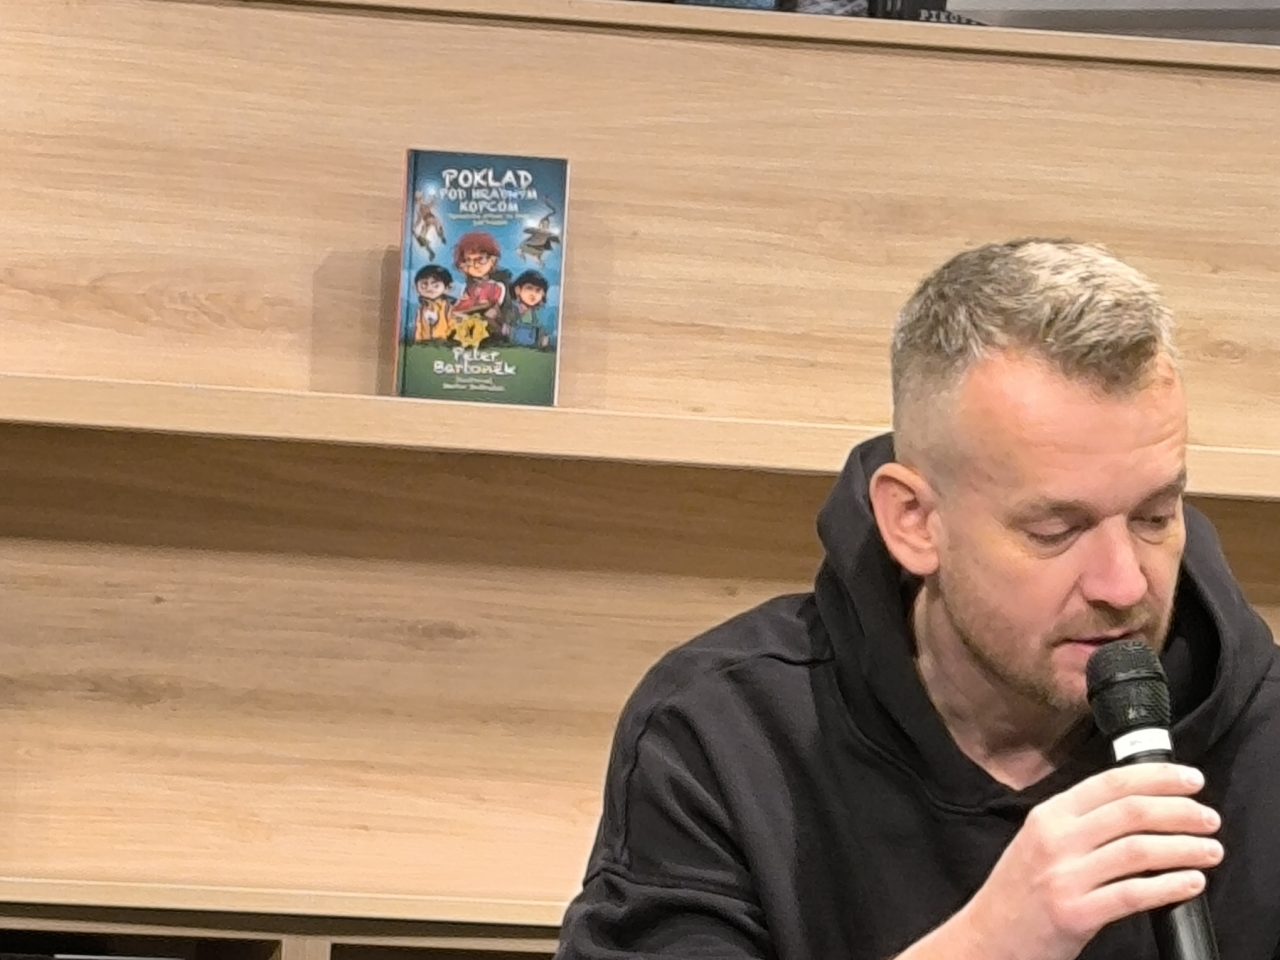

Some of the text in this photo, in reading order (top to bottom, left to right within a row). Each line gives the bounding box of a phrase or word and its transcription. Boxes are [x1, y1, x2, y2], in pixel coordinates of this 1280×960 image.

[442, 169, 532, 188] POKLAD
[439, 188, 466, 199] POD
[459, 200, 518, 213] KOPCOM
[452, 348, 499, 362] Peter
